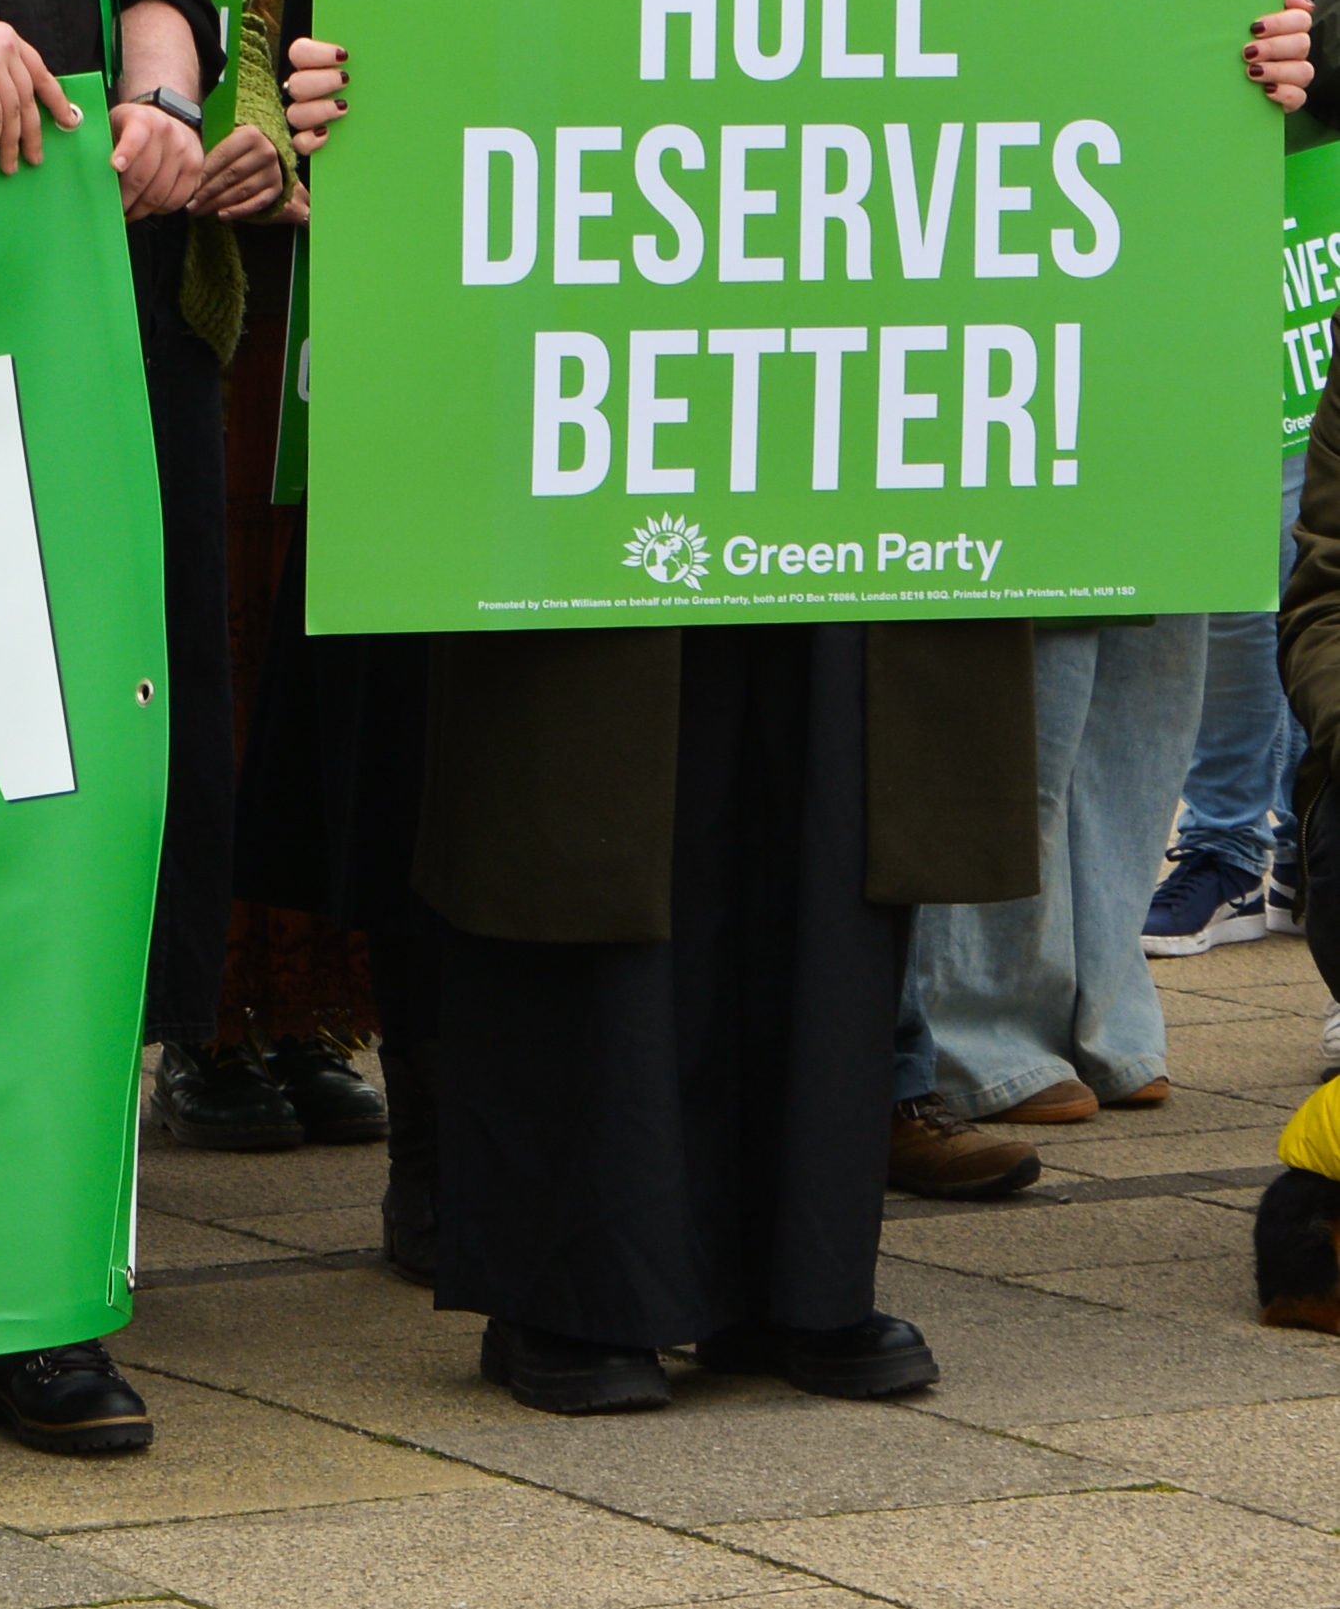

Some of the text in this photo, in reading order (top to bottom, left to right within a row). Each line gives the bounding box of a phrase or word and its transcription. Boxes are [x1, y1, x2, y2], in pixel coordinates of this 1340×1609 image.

[462, 120, 1120, 285] DESERVES
[532, 323, 1080, 496] BETTER!
[478, 600, 525, 610] Promoted
[528, 600, 539, 611] by
[542, 599, 568, 609] Chris
[571, 598, 611, 609] Williams
[614, 599, 626, 608] on
[629, 597, 660, 607] behalf
[662, 597, 672, 607] of
[674, 597, 689, 607] the
[692, 596, 721, 605] Green
[753, 594, 775, 604] both
[778, 594, 787, 603] at
[789, 593, 804, 603] PO
[806, 593, 825, 603] Box
[861, 592, 898, 603] London
[953, 590, 989, 599] Printed
[990, 590, 1002, 601] by
[1004, 589, 1024, 598] Fisk
[724, 533, 1003, 582] Green Party
